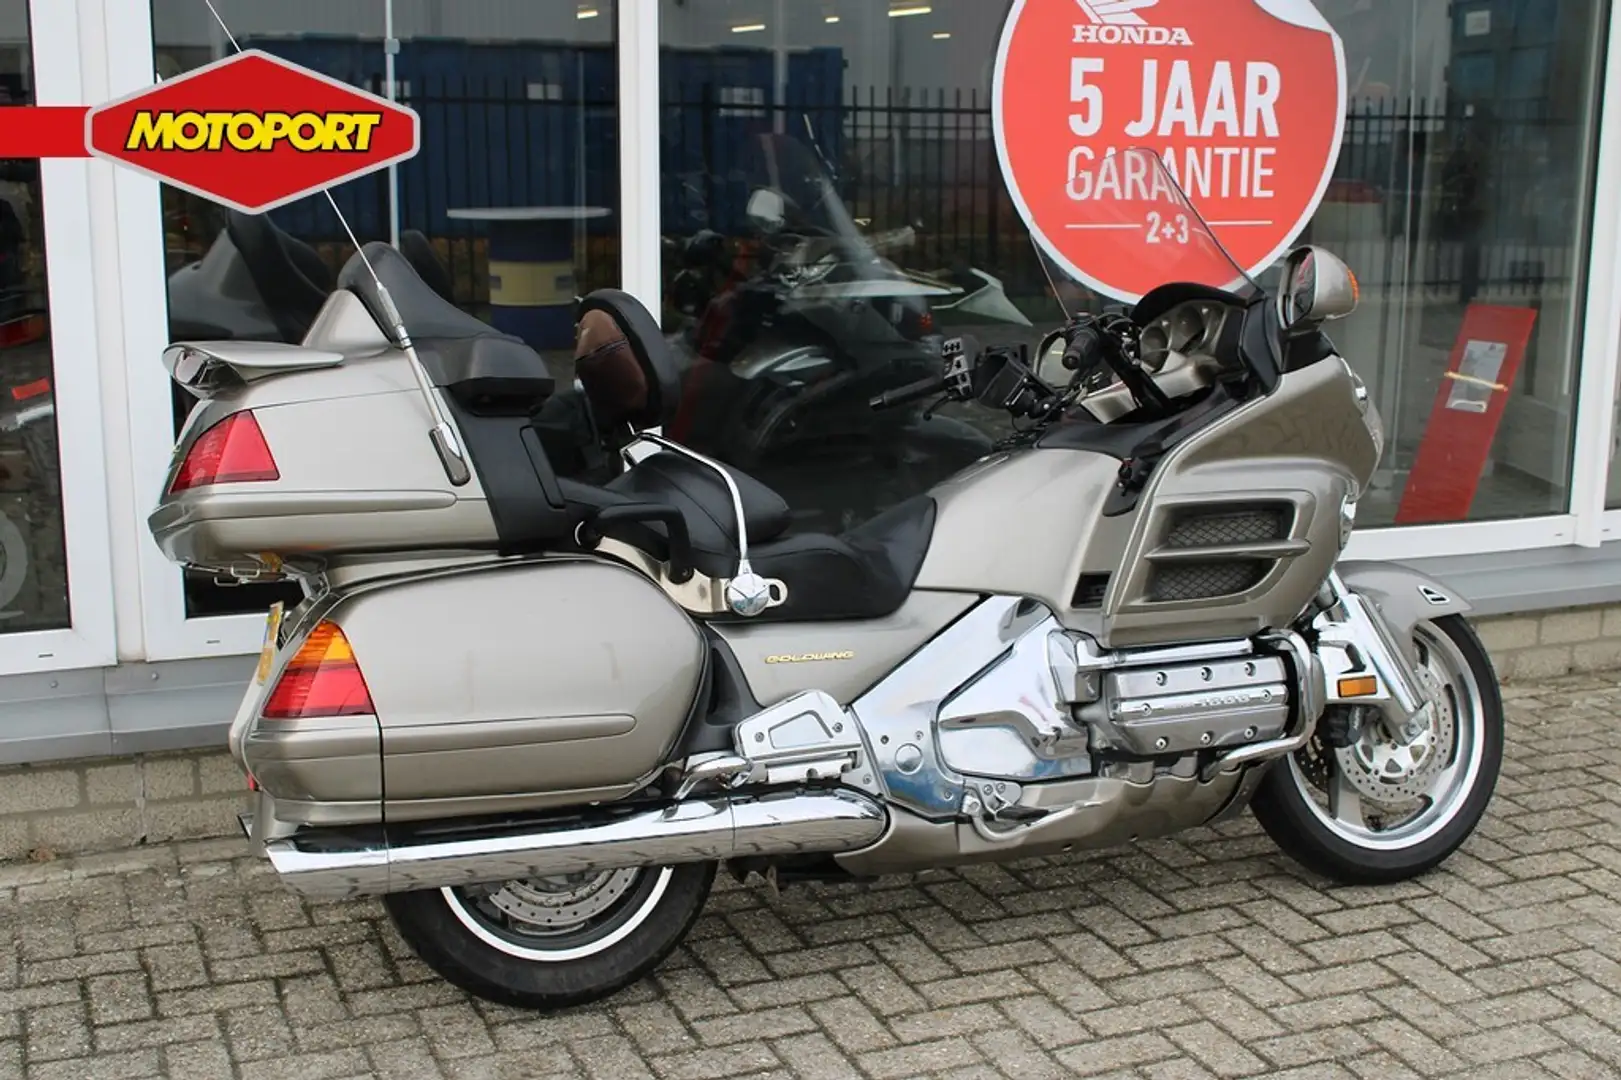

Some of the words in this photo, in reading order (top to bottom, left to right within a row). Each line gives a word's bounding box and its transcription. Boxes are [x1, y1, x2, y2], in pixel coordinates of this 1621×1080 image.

[1072, 24, 1194, 46] HONDA
[1068, 57, 1105, 137] 5
[1124, 59, 1281, 138] JAAR
[1066, 146, 1277, 205] GARANTIE
[1146, 211, 1189, 244] 2+3
